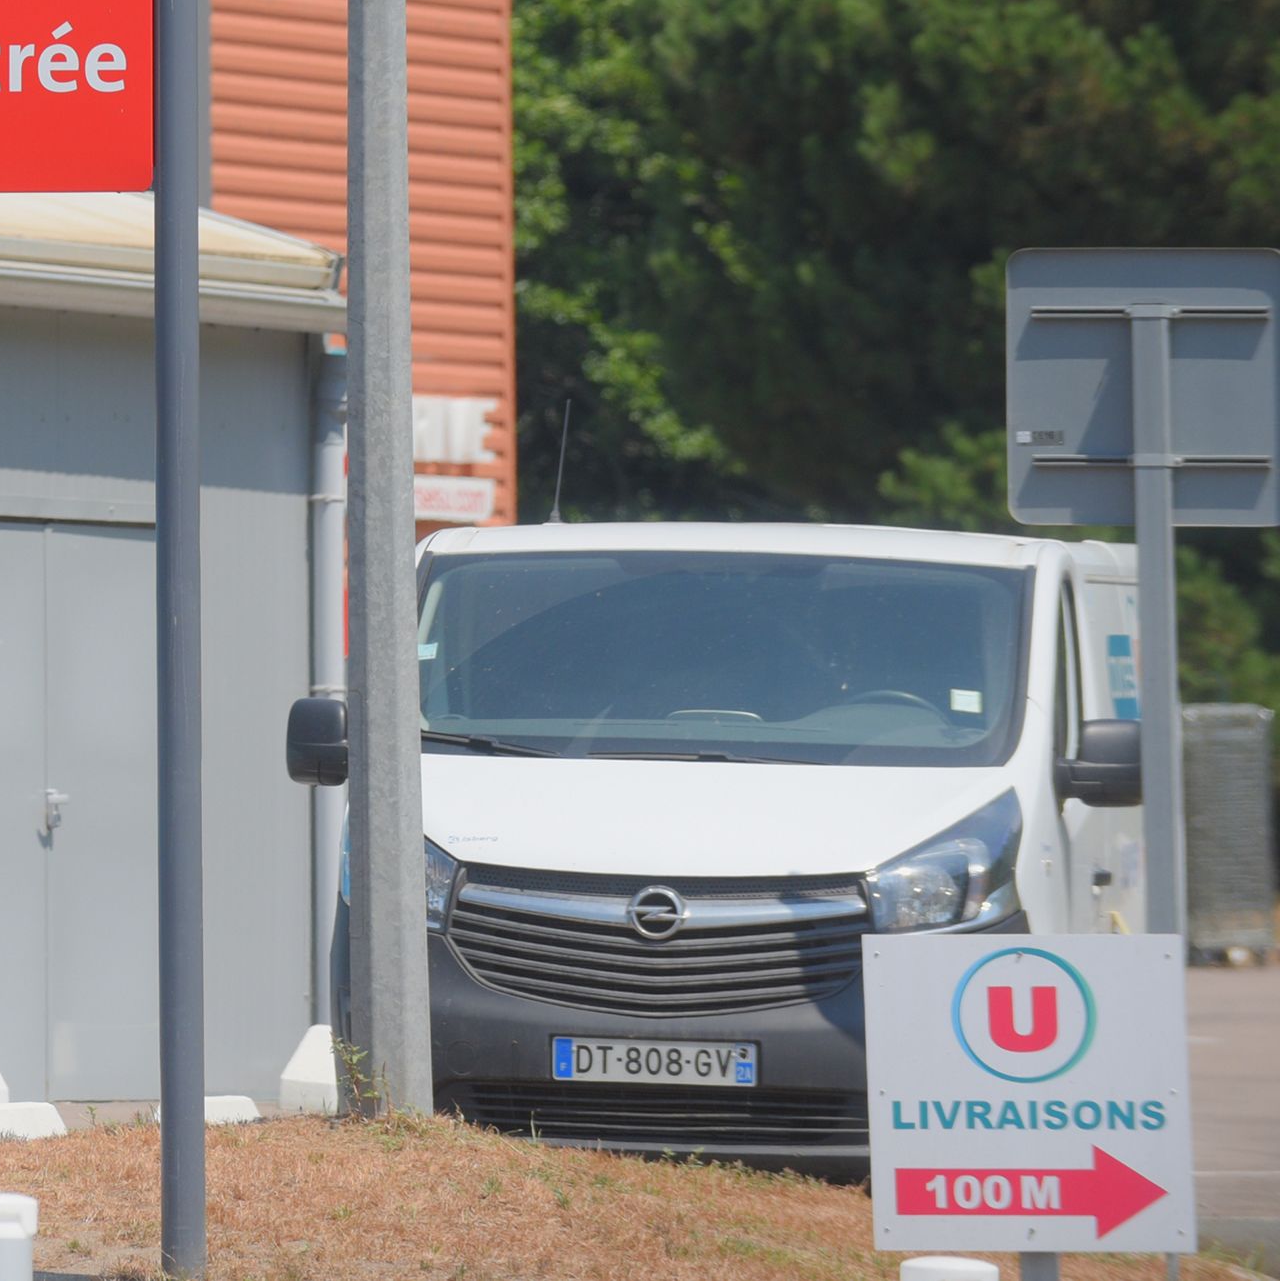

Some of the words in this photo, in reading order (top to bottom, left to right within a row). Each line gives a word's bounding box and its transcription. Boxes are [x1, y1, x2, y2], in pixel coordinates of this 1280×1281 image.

[988, 986, 1058, 1053] U
[575, 1045, 731, 1078] DT-808-GV
[892, 1100, 1166, 1131] LIVRAISONS
[925, 1174, 1013, 1210] 100
[1020, 1175, 1062, 1210] M
